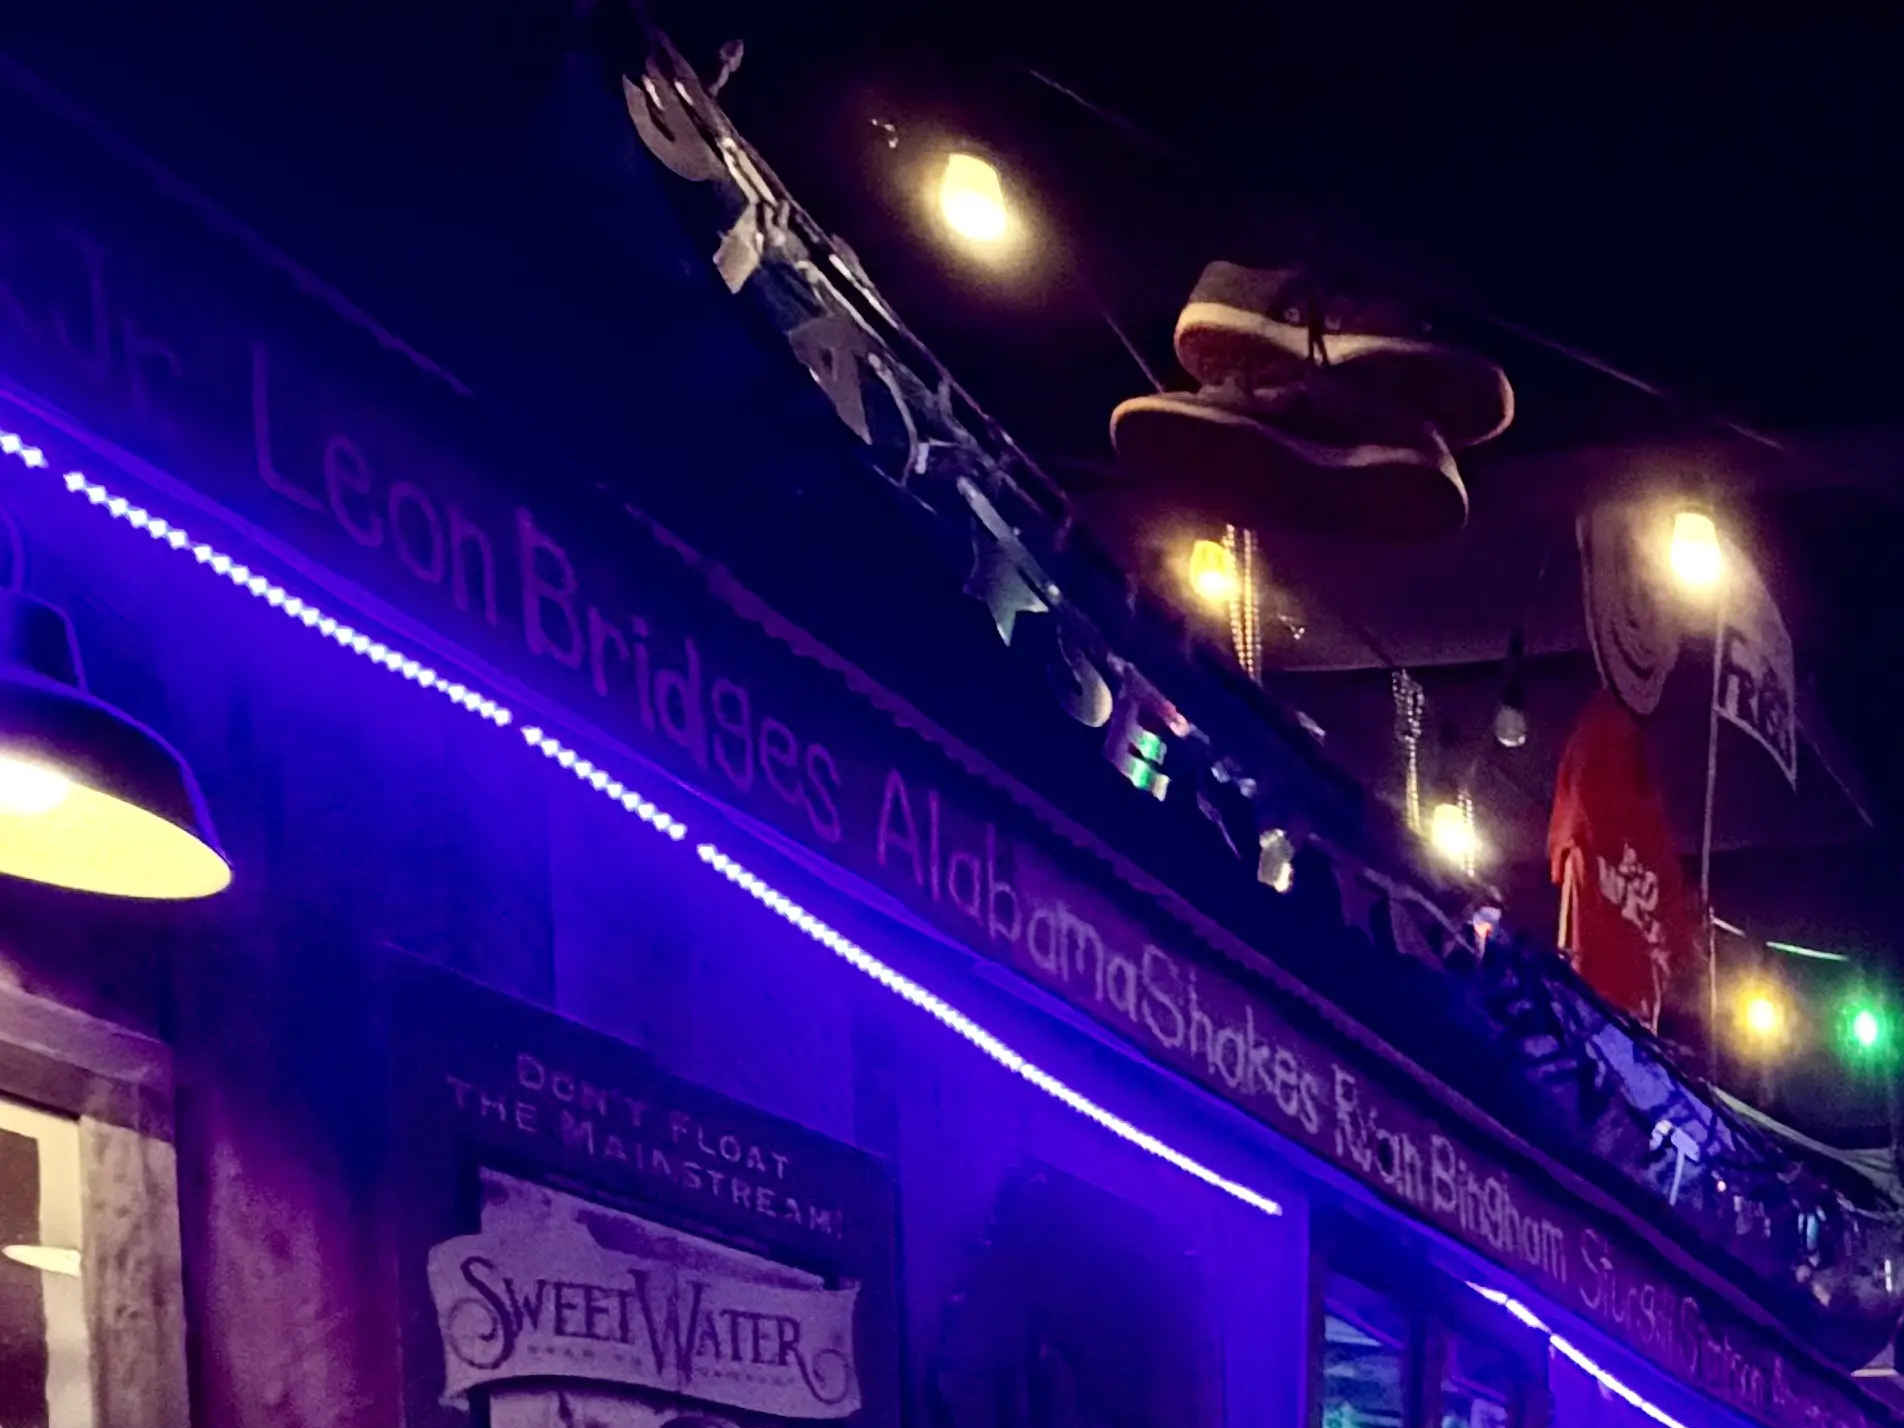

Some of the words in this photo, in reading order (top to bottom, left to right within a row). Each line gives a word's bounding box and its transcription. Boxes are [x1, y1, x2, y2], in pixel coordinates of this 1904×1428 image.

[517, 505, 843, 844] Bridges
[444, 1072, 539, 1134] THE
[670, 1109, 791, 1181] FLOAT
